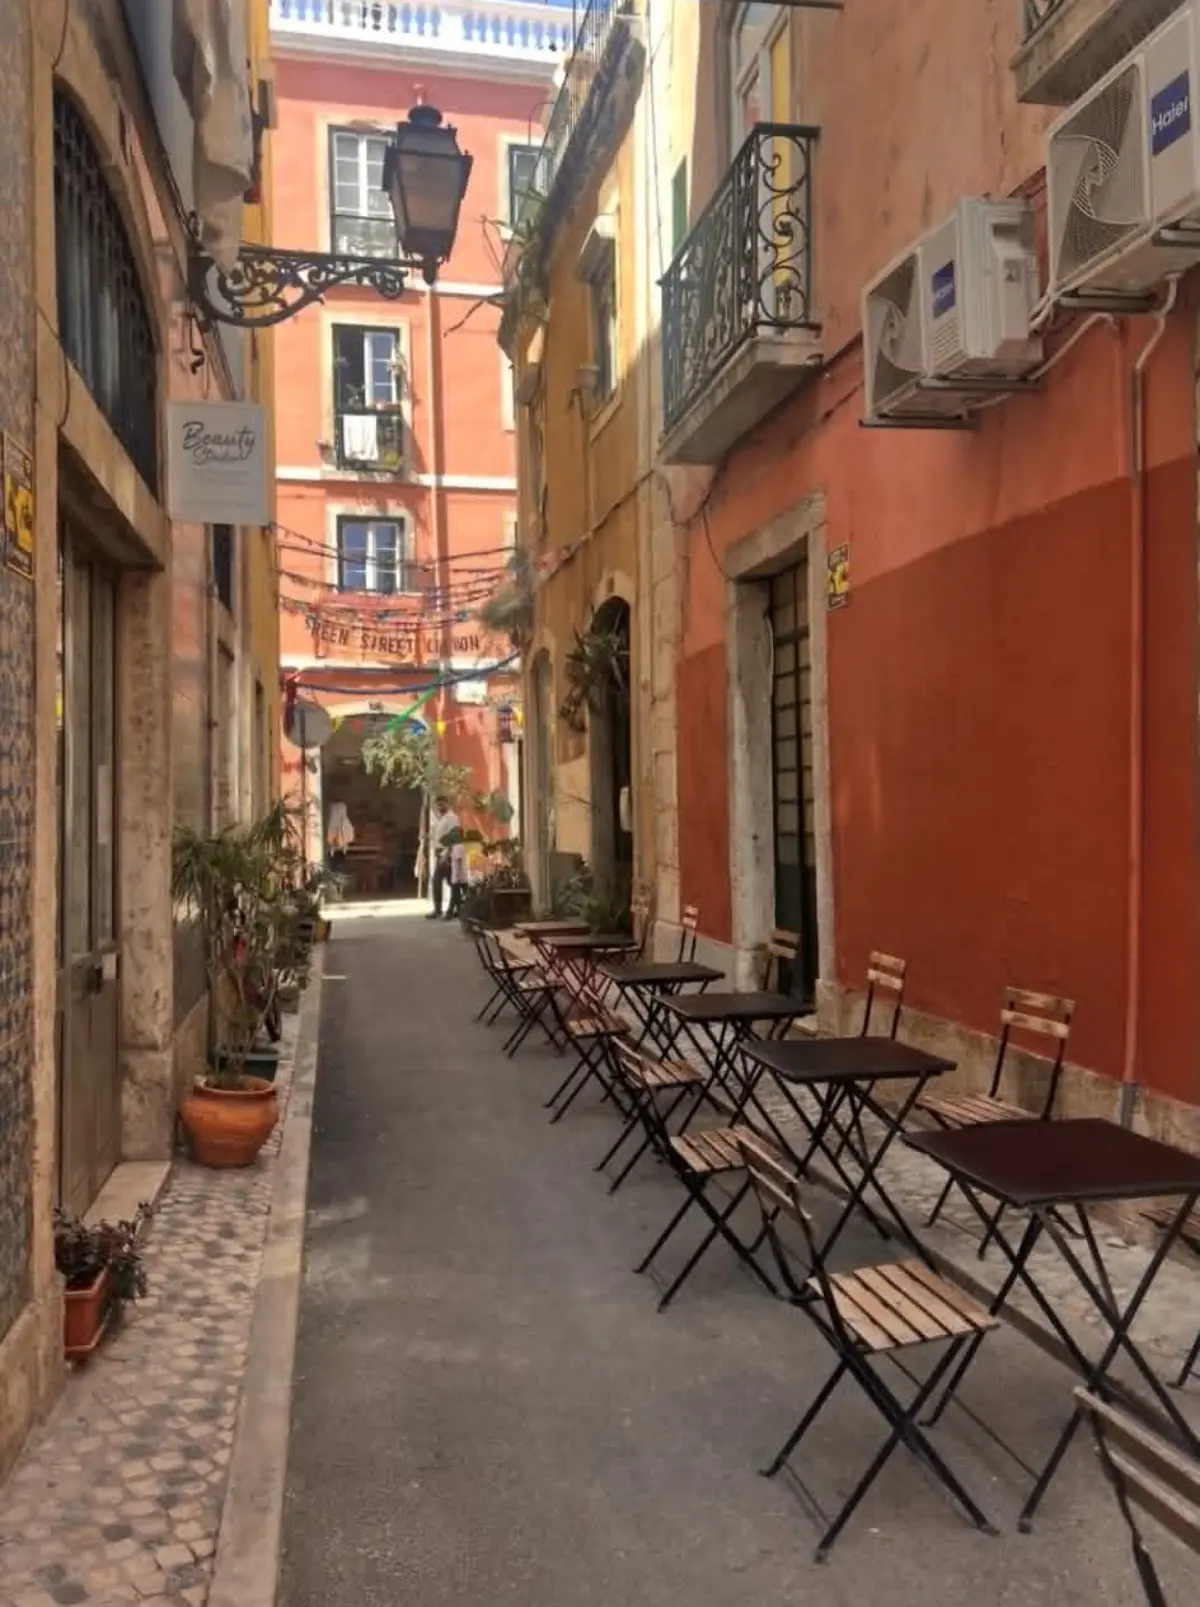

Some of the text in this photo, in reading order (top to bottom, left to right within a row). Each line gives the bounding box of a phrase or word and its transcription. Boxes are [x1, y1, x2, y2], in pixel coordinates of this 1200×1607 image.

[182, 420, 255, 459] Beauty
[360, 631, 413, 653] STREET
[426, 633, 480, 654] LION
